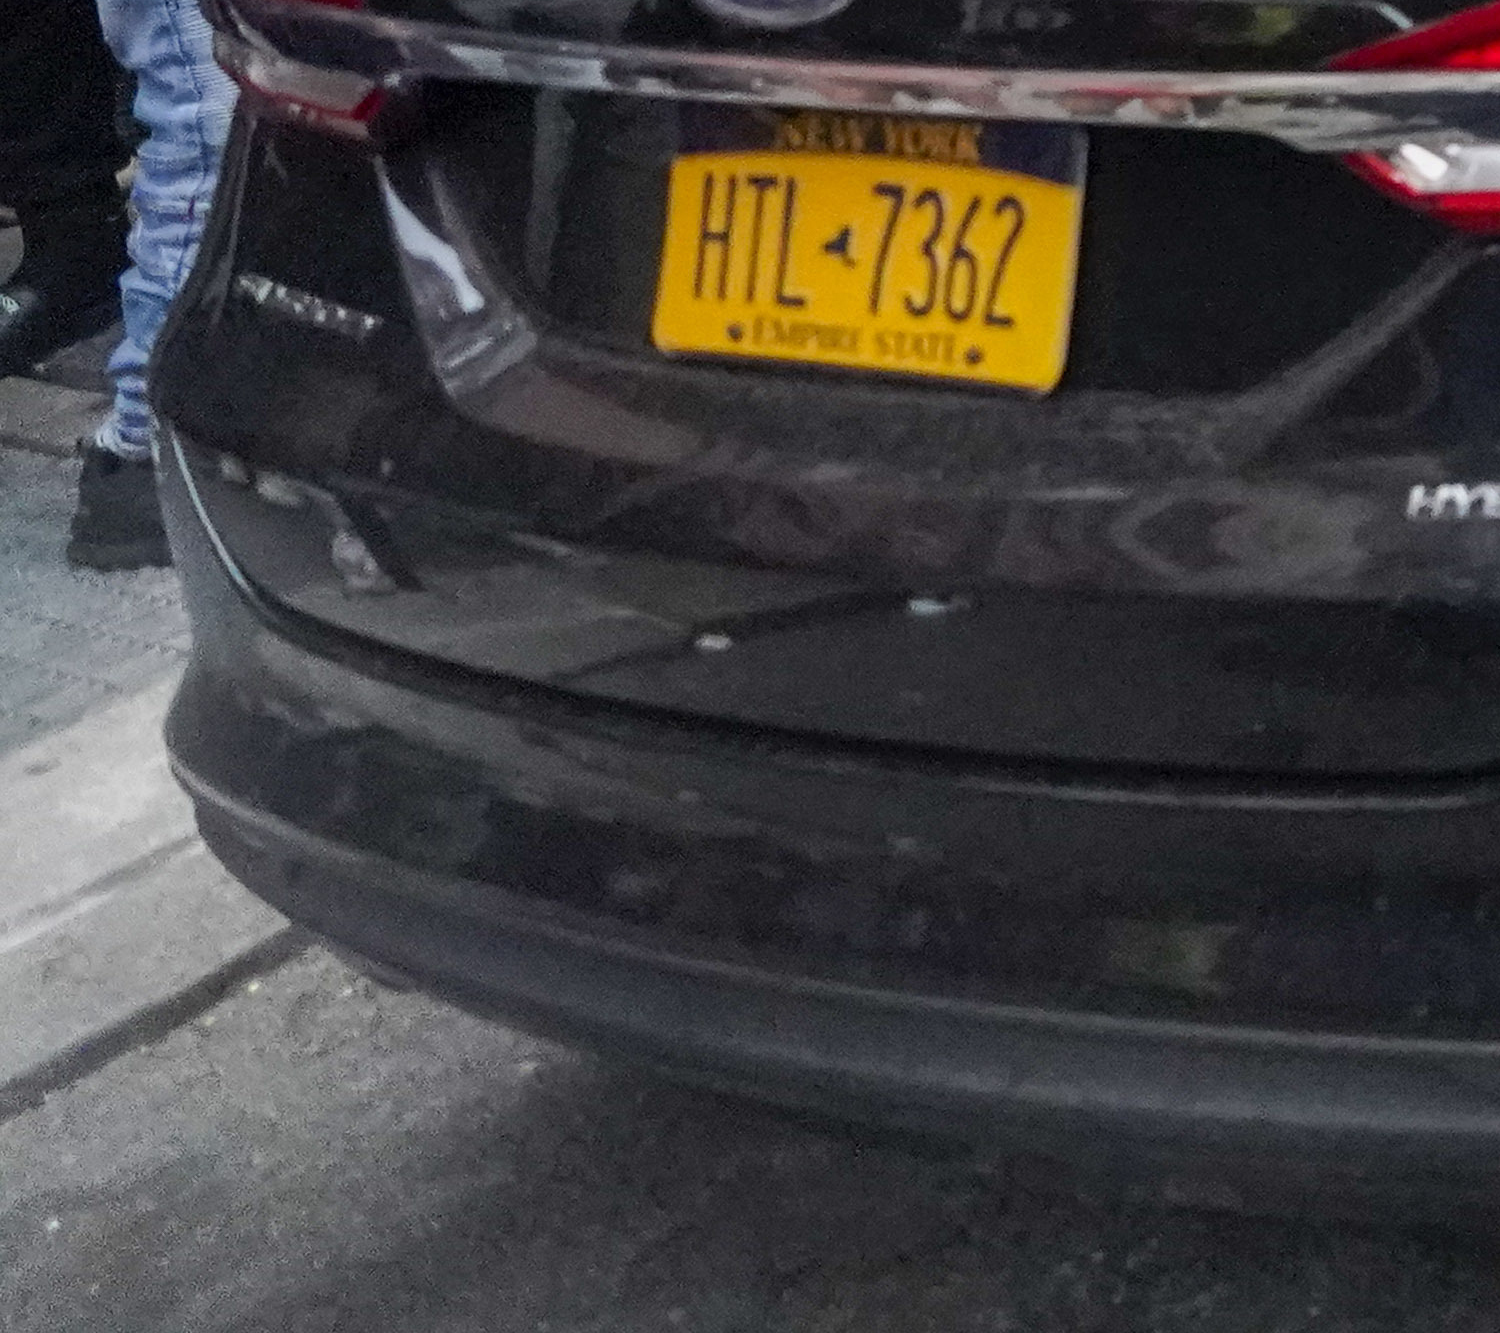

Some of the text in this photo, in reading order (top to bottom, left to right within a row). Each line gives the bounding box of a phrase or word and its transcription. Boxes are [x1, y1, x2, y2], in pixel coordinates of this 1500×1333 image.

[693, 171, 1026, 328] HTL 7362
[752, 317, 957, 365] EMPIRE STATE
